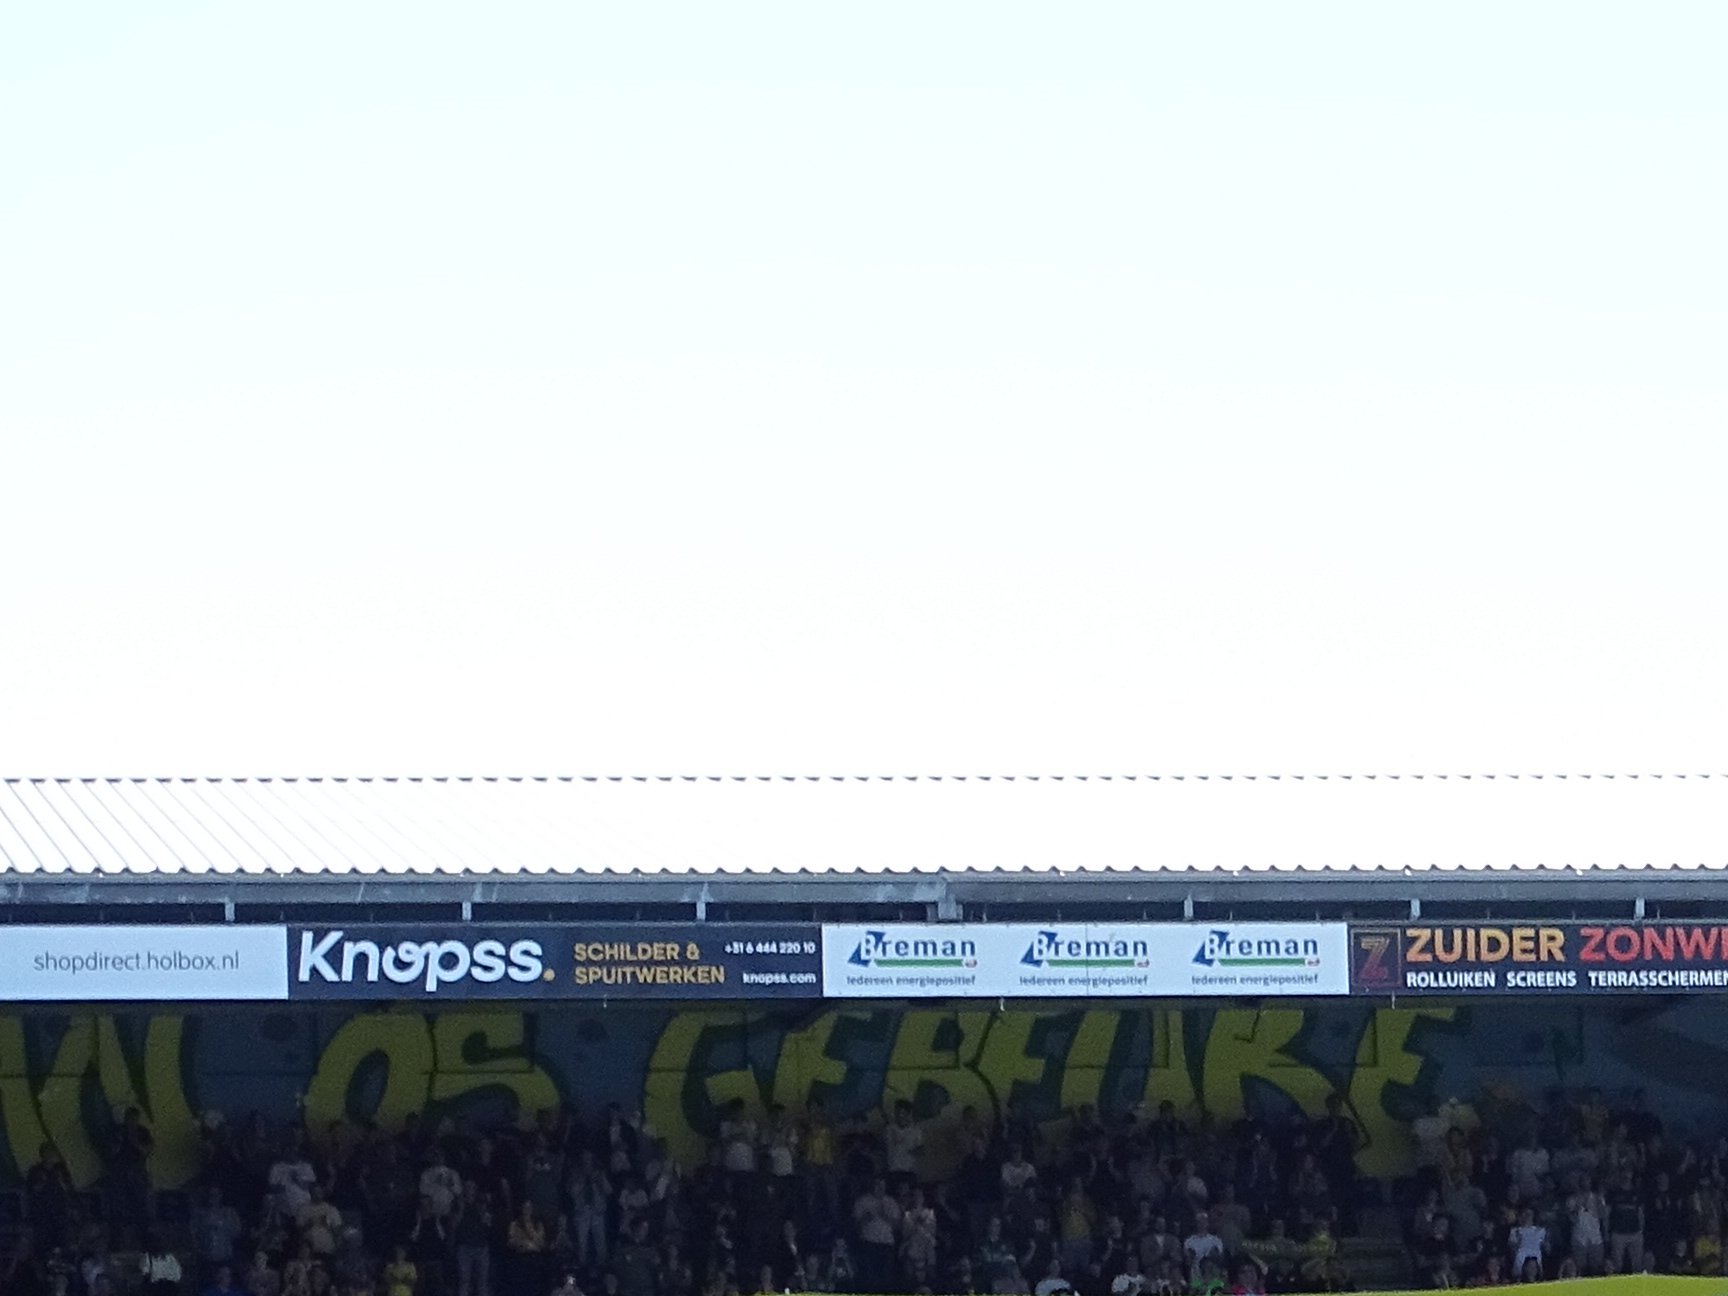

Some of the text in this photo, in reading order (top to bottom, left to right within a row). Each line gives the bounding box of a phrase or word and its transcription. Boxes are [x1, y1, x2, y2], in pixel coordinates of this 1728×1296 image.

[575, 943, 700, 961] SCHILDER &
[802, 942, 815, 954] 10
[862, 933, 976, 958] Breman
[1033, 933, 1148, 958] Breman
[1206, 932, 1319, 957] Breman
[1406, 927, 1565, 963] ZUIDER
[34, 950, 240, 974] shopdirect.holbox.nl
[574, 966, 725, 984] SPUITWERKEN
[742, 971, 816, 985] knopss.com
[1406, 970, 1496, 988] ROLLUIKEN
[1506, 970, 1577, 988] SCREENS
